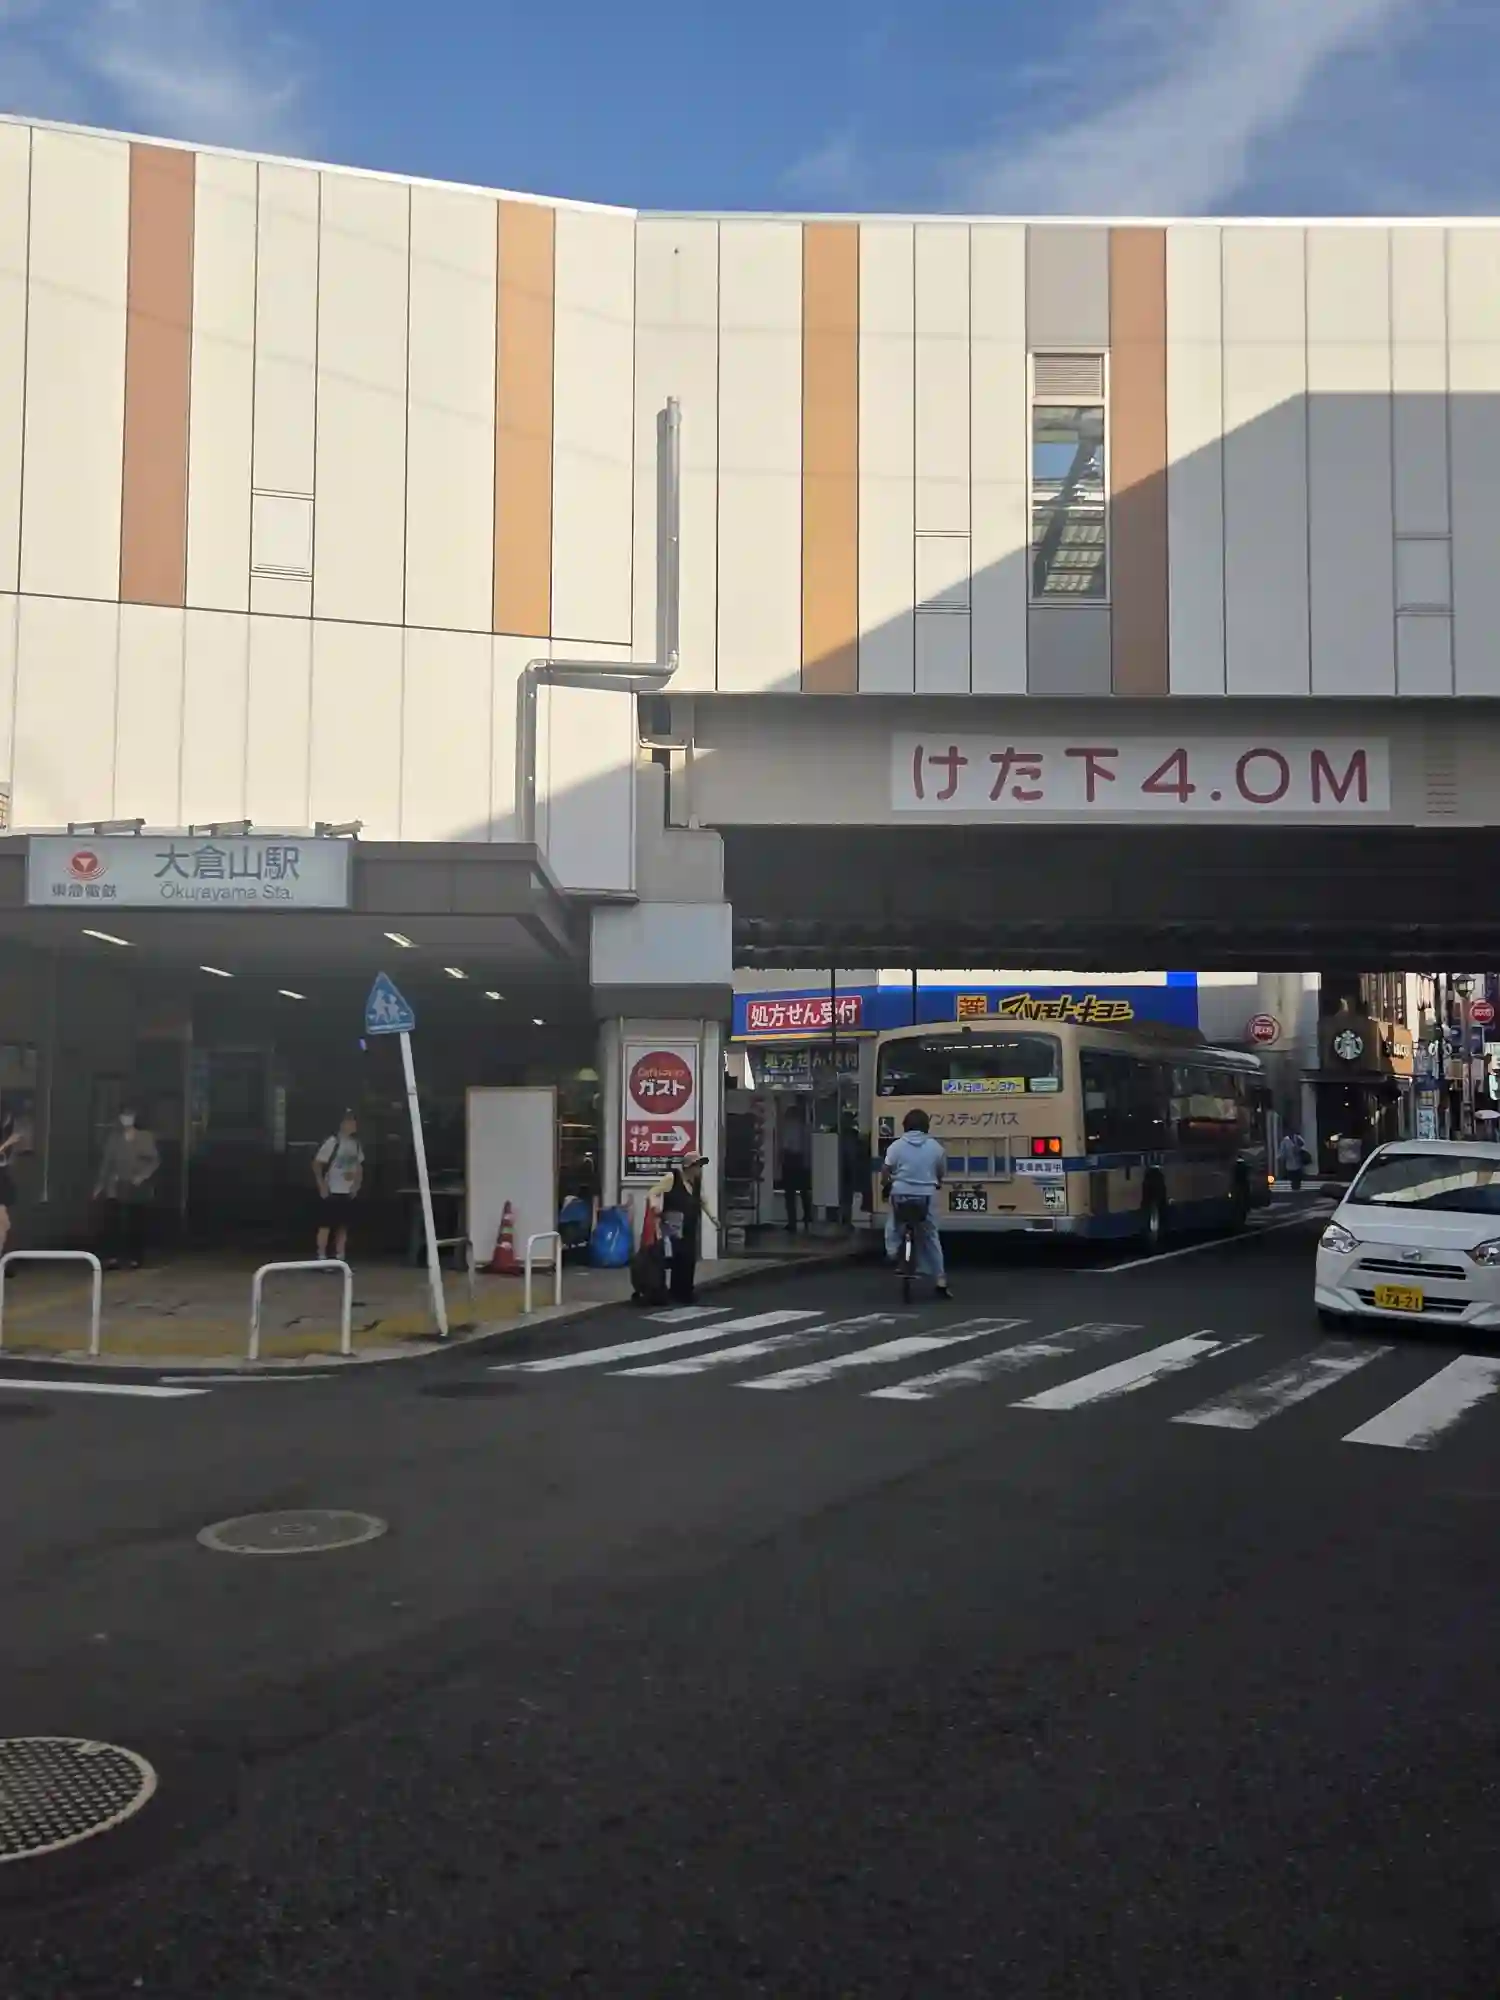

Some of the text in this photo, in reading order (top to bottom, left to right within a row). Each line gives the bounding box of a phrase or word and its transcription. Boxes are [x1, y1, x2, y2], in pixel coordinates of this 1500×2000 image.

[154, 844, 300, 880] 大倉山駅
[160, 880, 294, 901] Ōkurayama Sta.
[751, 999, 858, 1028] 処方せん受付
[1000, 993, 1133, 1023] マツモトキヨシ
[638, 1079, 686, 1096] ガスト
[630, 1137, 650, 1152] 1分
